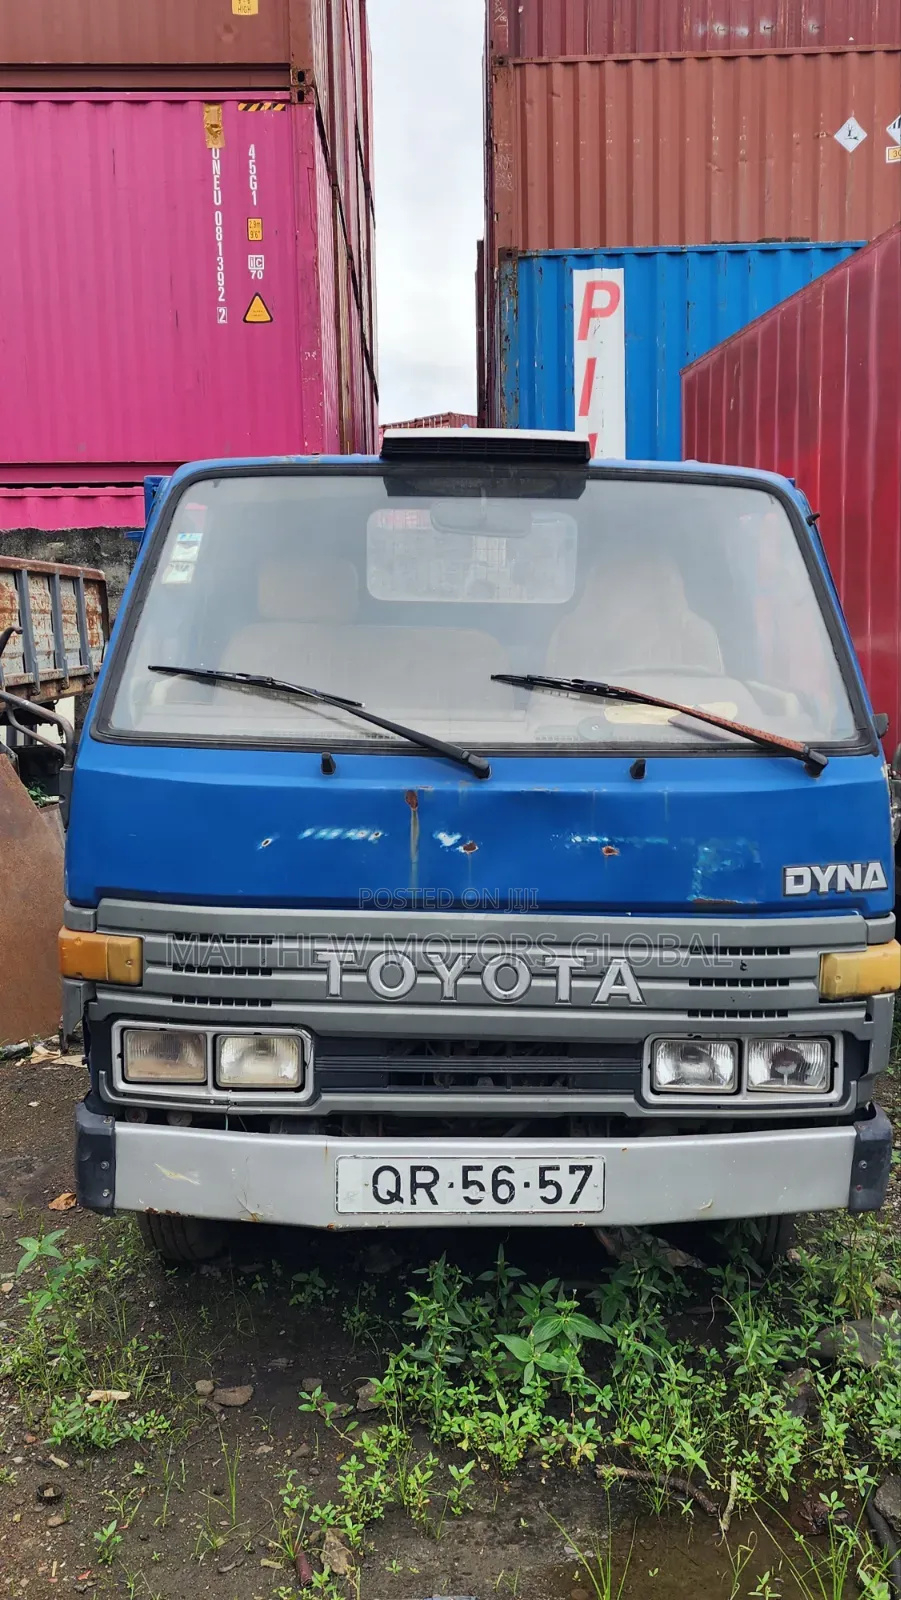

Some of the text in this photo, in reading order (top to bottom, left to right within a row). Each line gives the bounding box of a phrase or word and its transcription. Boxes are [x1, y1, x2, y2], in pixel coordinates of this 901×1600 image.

[248, 144, 257, 205] 45G1
[215, 211, 225, 301] 081392
[250, 270, 263, 279] 70
[218, 307, 227, 323] 2
[784, 862, 888, 895] DYNA
[313, 950, 647, 1006] TOYOTA
